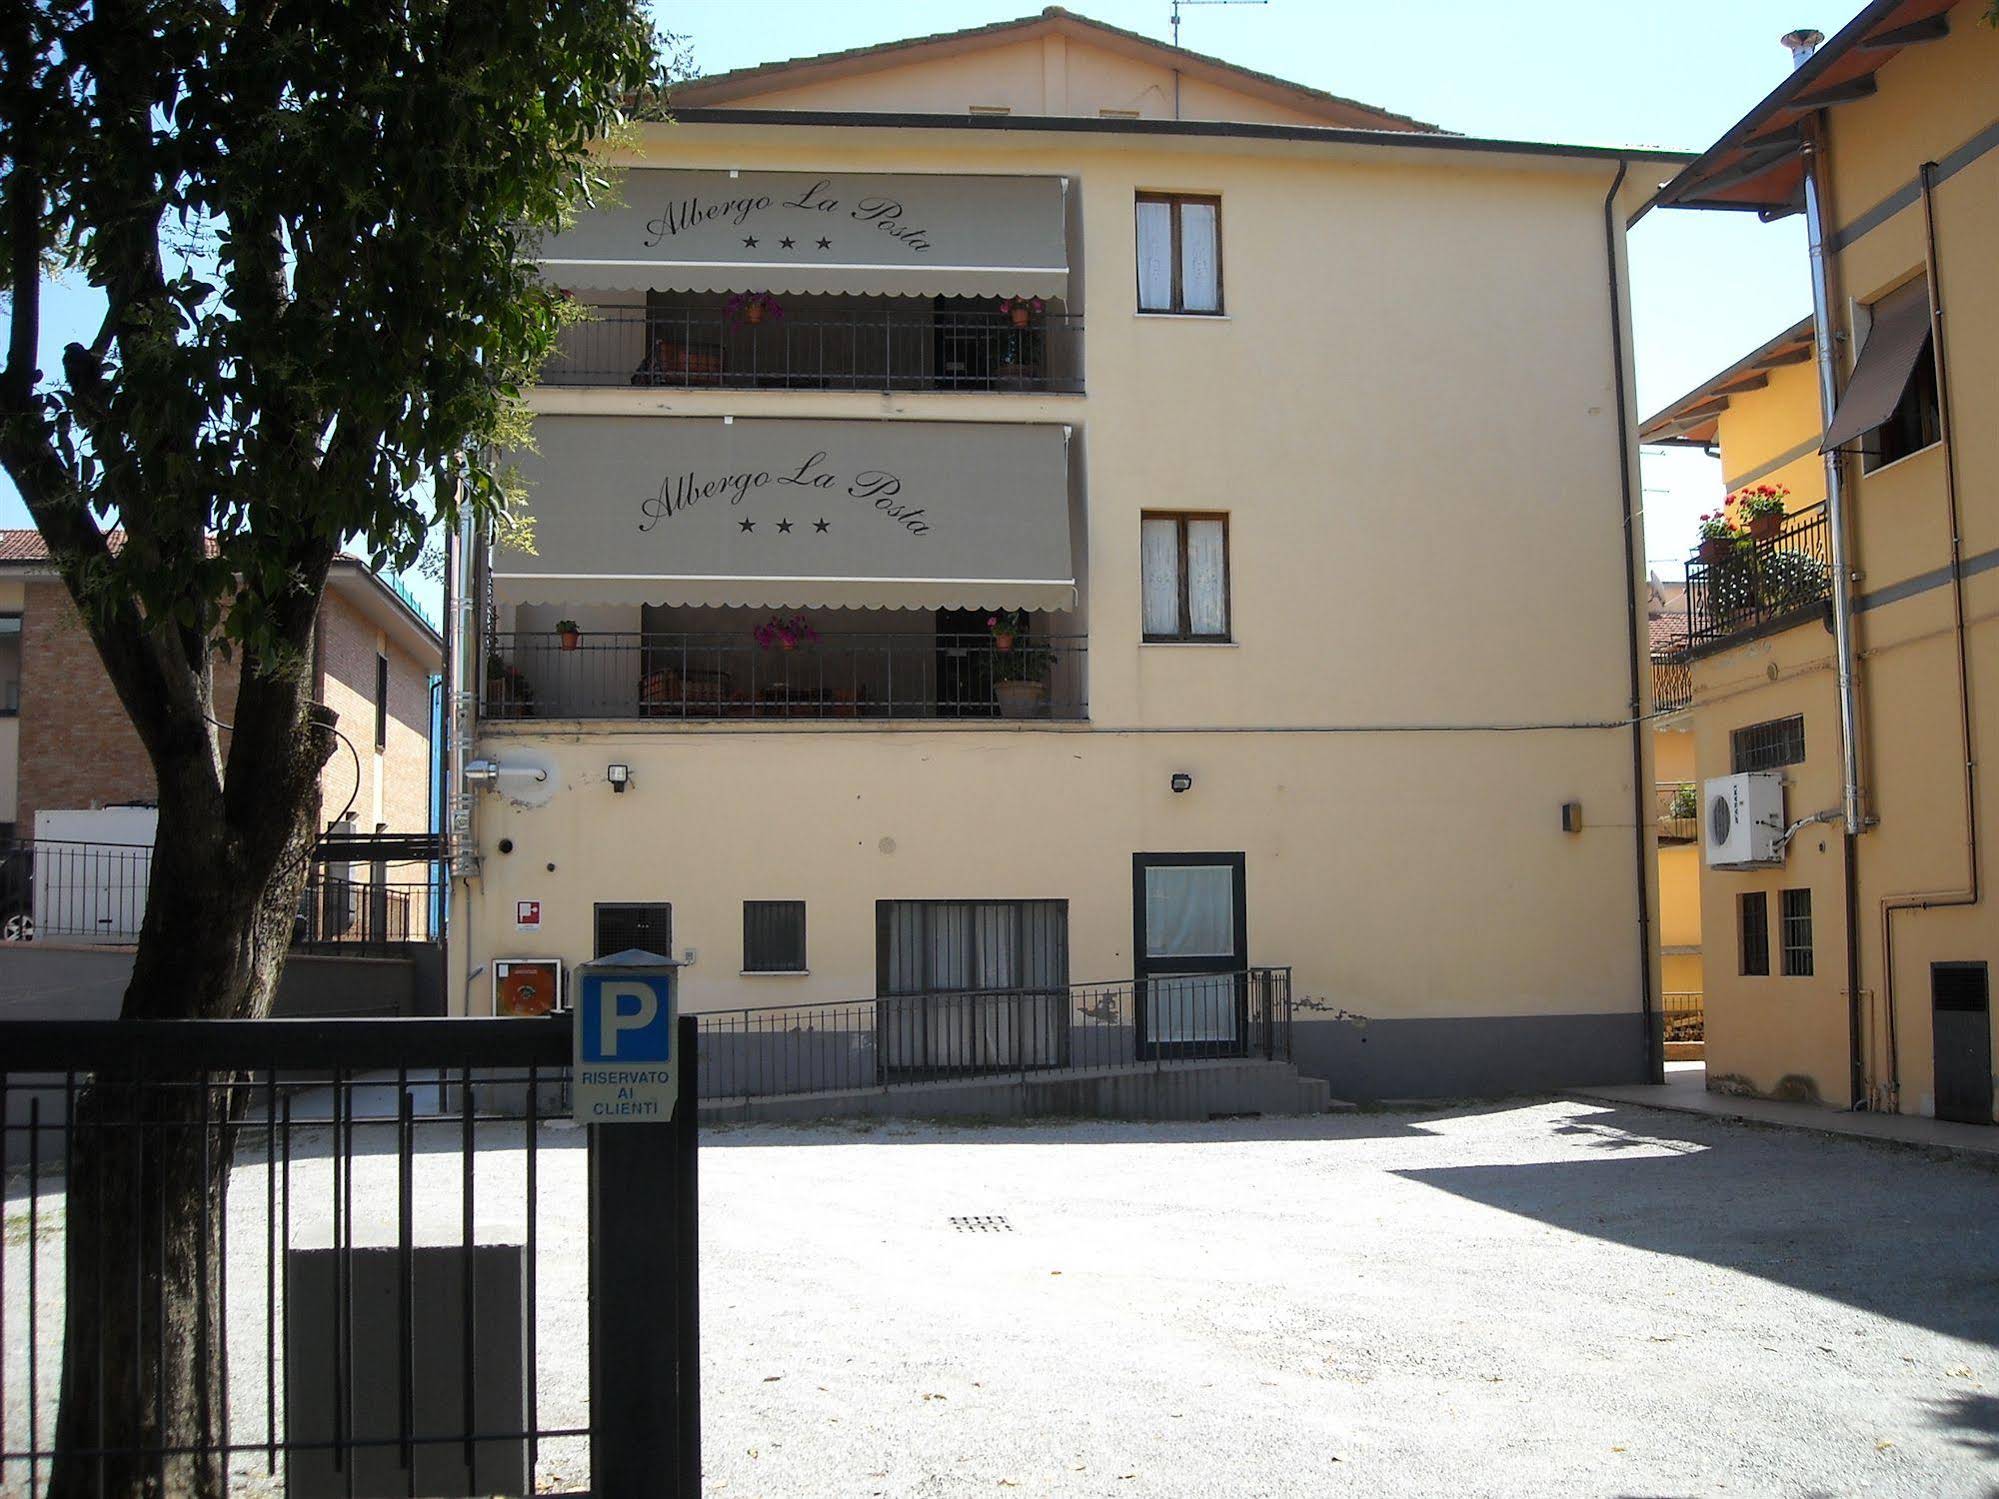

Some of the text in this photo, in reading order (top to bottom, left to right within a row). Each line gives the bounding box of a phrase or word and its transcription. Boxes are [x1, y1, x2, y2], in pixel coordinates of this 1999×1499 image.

[644, 179, 931, 251] Albergo La Posta
[639, 451, 931, 537] Albergo La Posta
[600, 981, 658, 1056] P
[582, 1071, 669, 1085] RISERVATO
[617, 1087, 633, 1099] AI
[593, 1102, 657, 1116] CLIENTI
